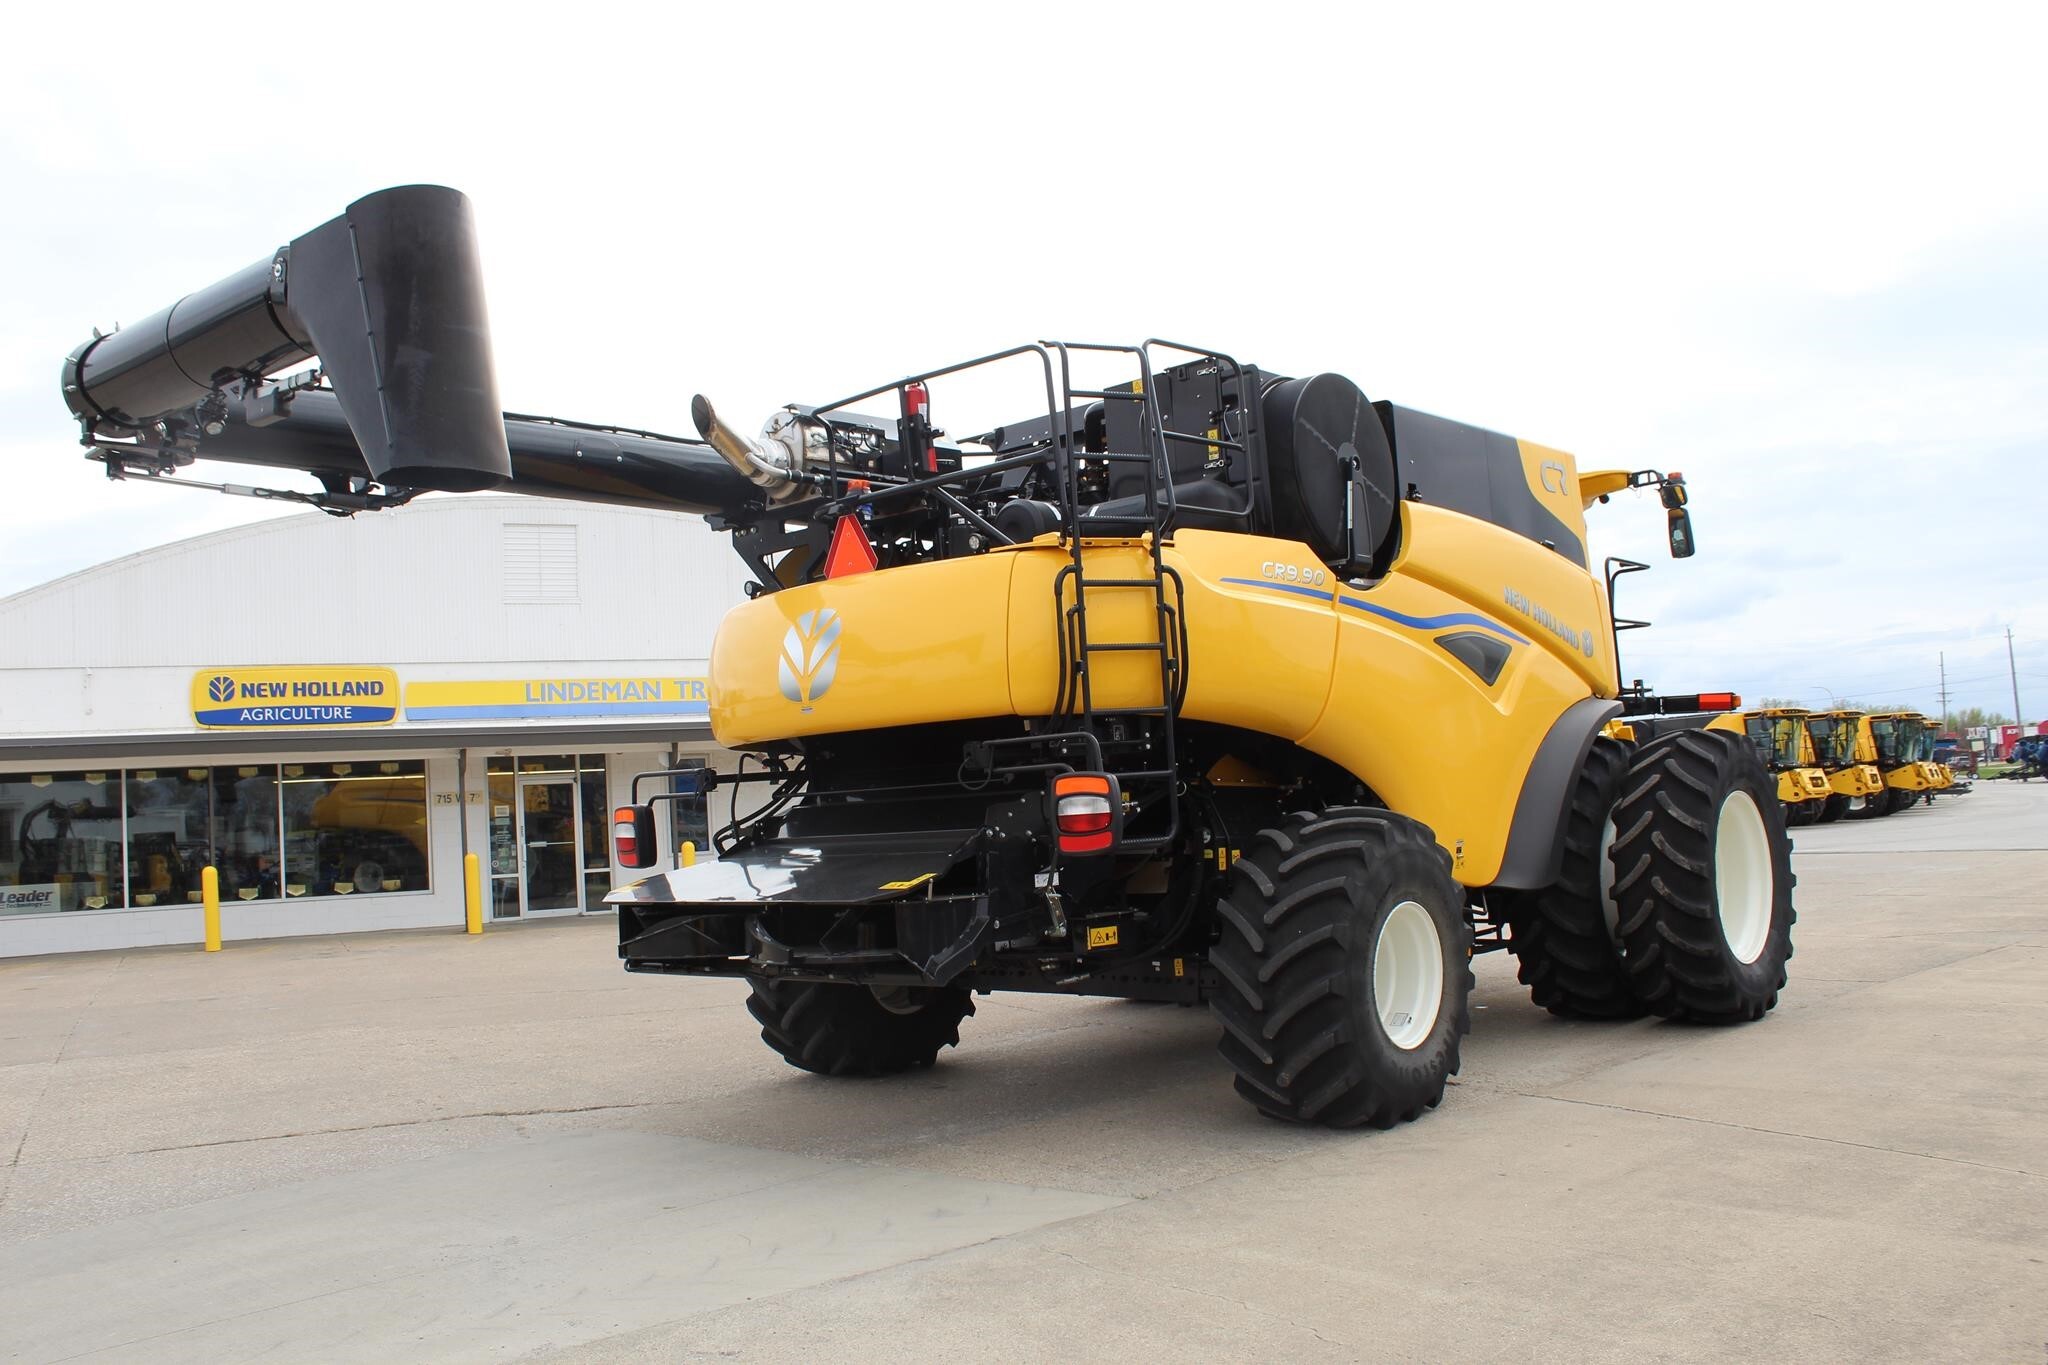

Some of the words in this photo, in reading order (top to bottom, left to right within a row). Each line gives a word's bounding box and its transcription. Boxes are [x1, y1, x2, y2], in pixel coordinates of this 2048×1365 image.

[1540, 460, 1568, 497] CR
[1261, 560, 1326, 587] CR9.90
[1503, 584, 1530, 617] NEW
[1532, 602, 1580, 651] HOLLAND
[240, 682, 288, 698] NEW
[292, 680, 385, 698] HOLLAND
[524, 680, 662, 703] LINDEMAN
[239, 706, 353, 722] AGRICULTURE
[436, 794, 452, 804] 715
[0, 890, 53, 903] Leader
